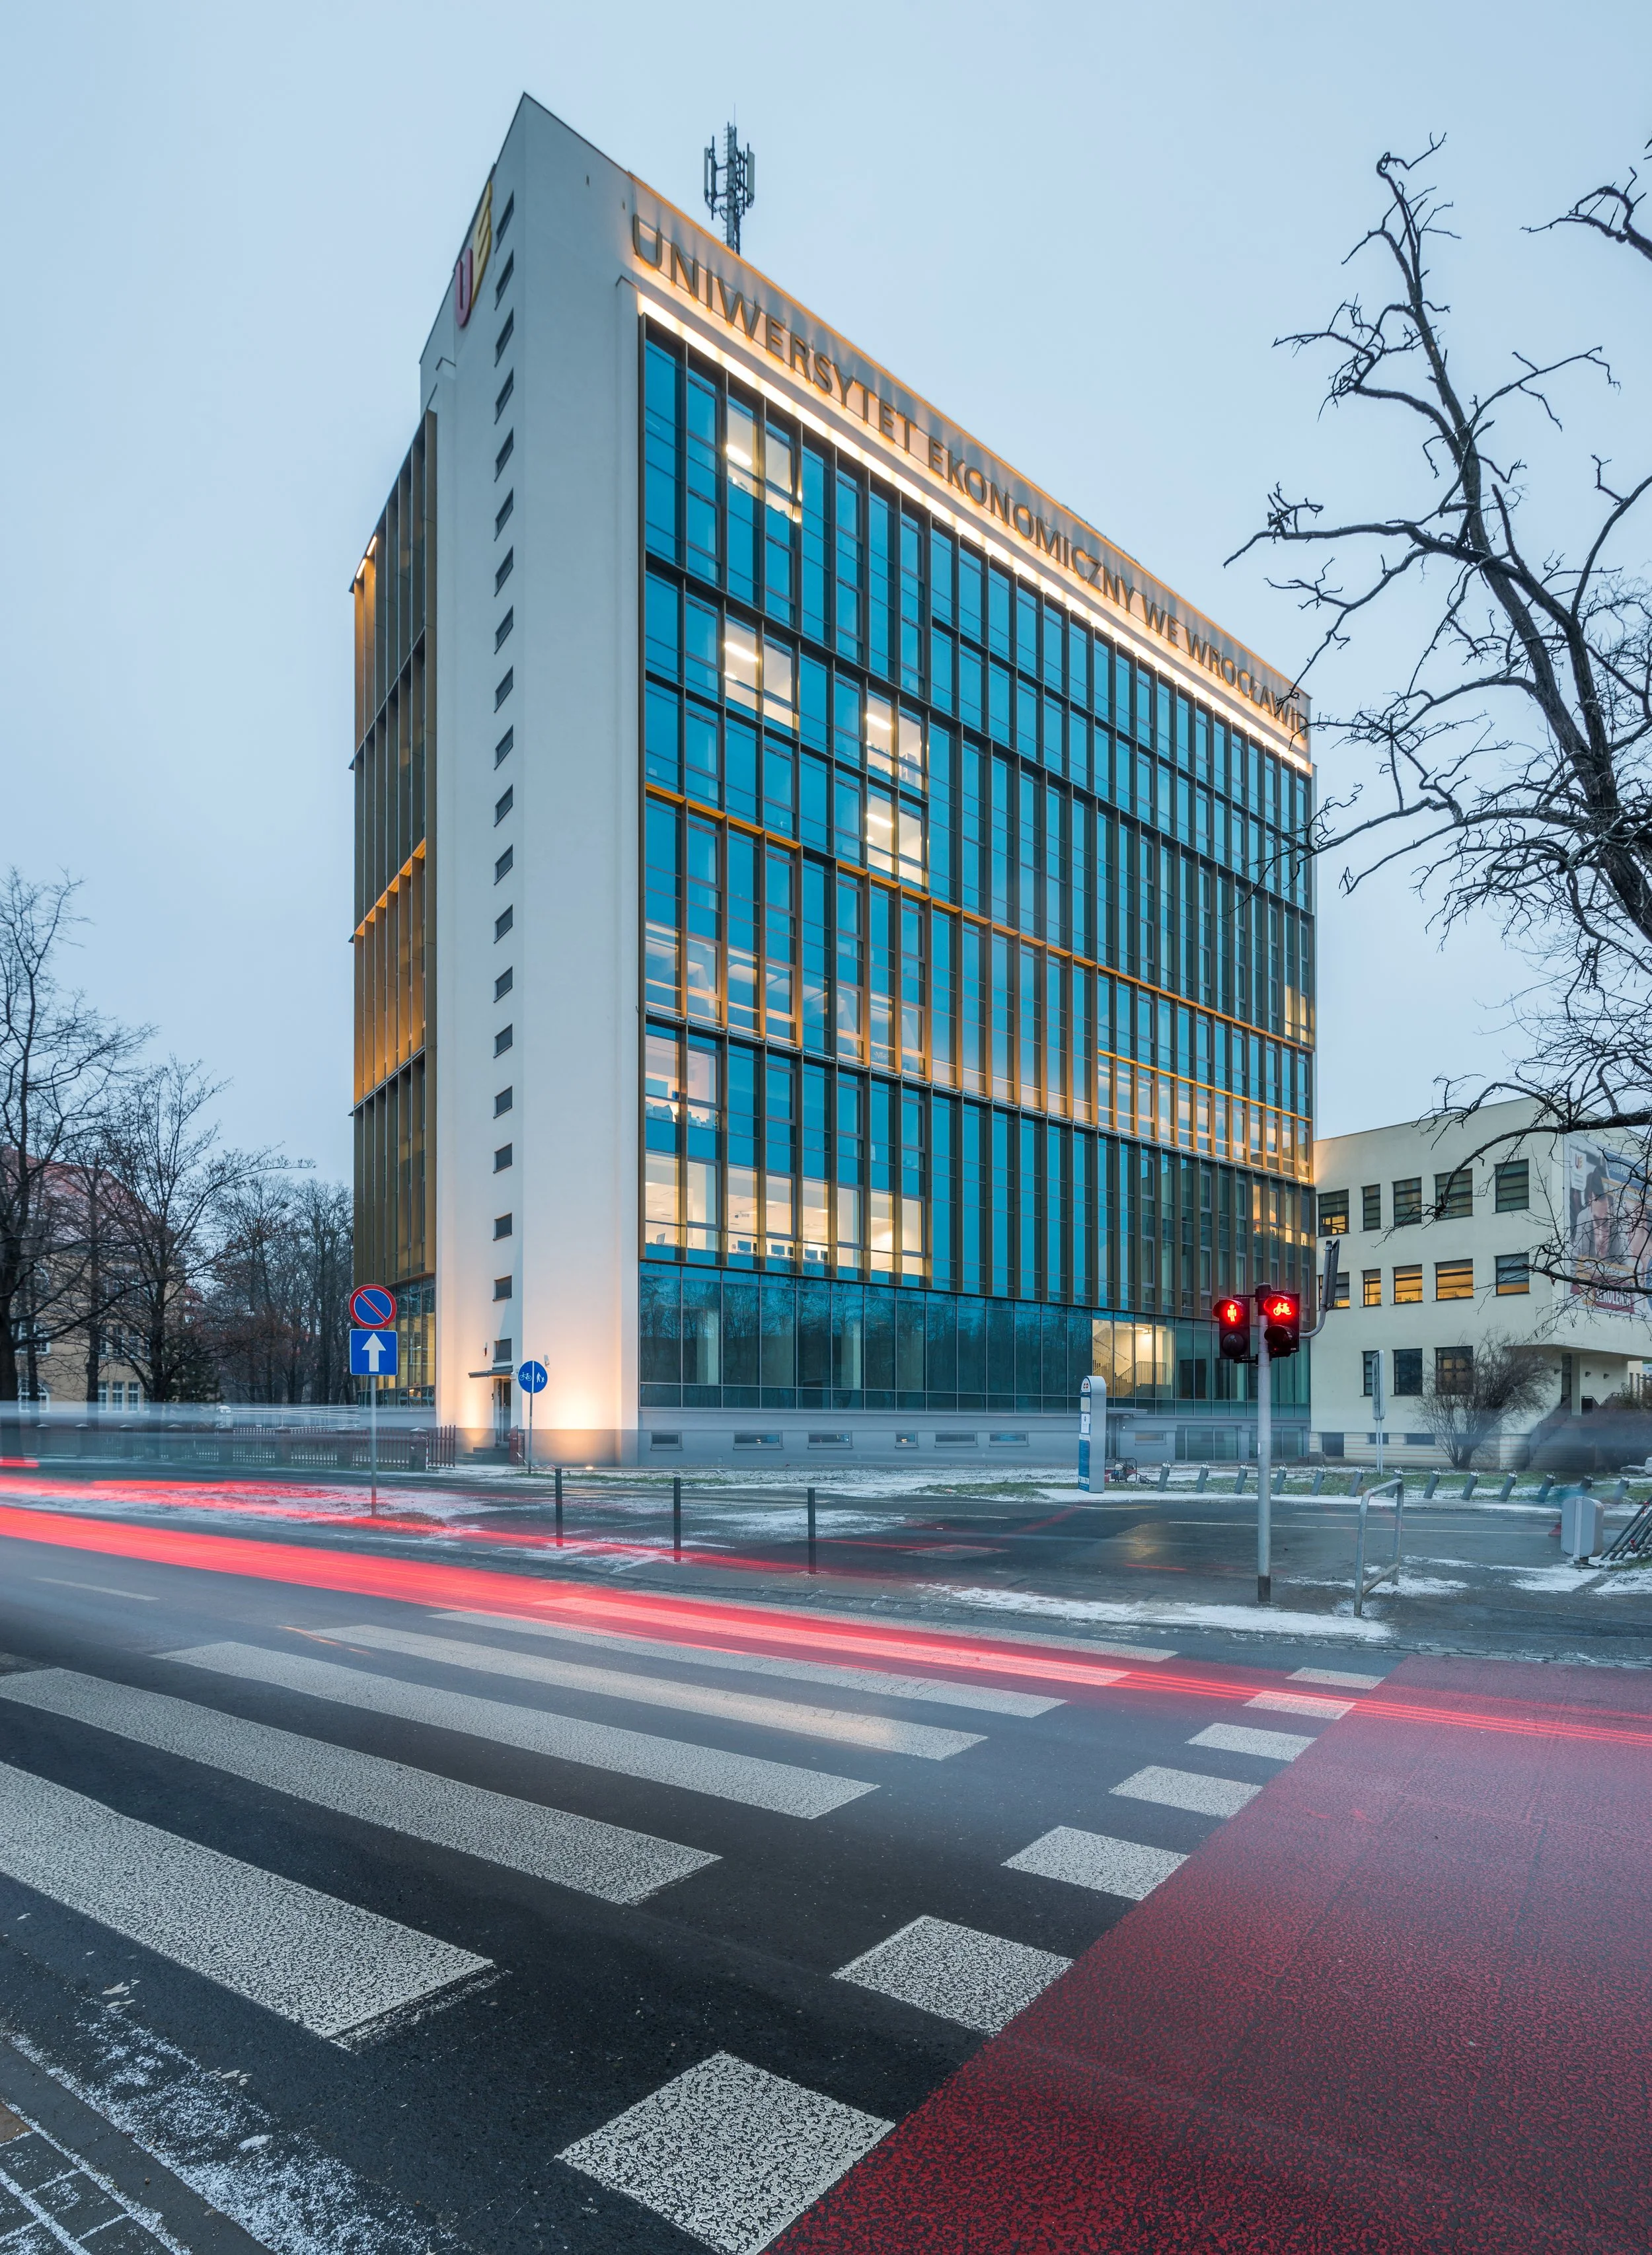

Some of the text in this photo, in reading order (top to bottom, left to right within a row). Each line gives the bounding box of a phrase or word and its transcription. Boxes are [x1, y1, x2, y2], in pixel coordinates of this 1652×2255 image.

[632, 213, 1309, 741] UNIWERSYTET EKONOMICZNY WE WROCŁAWIU
